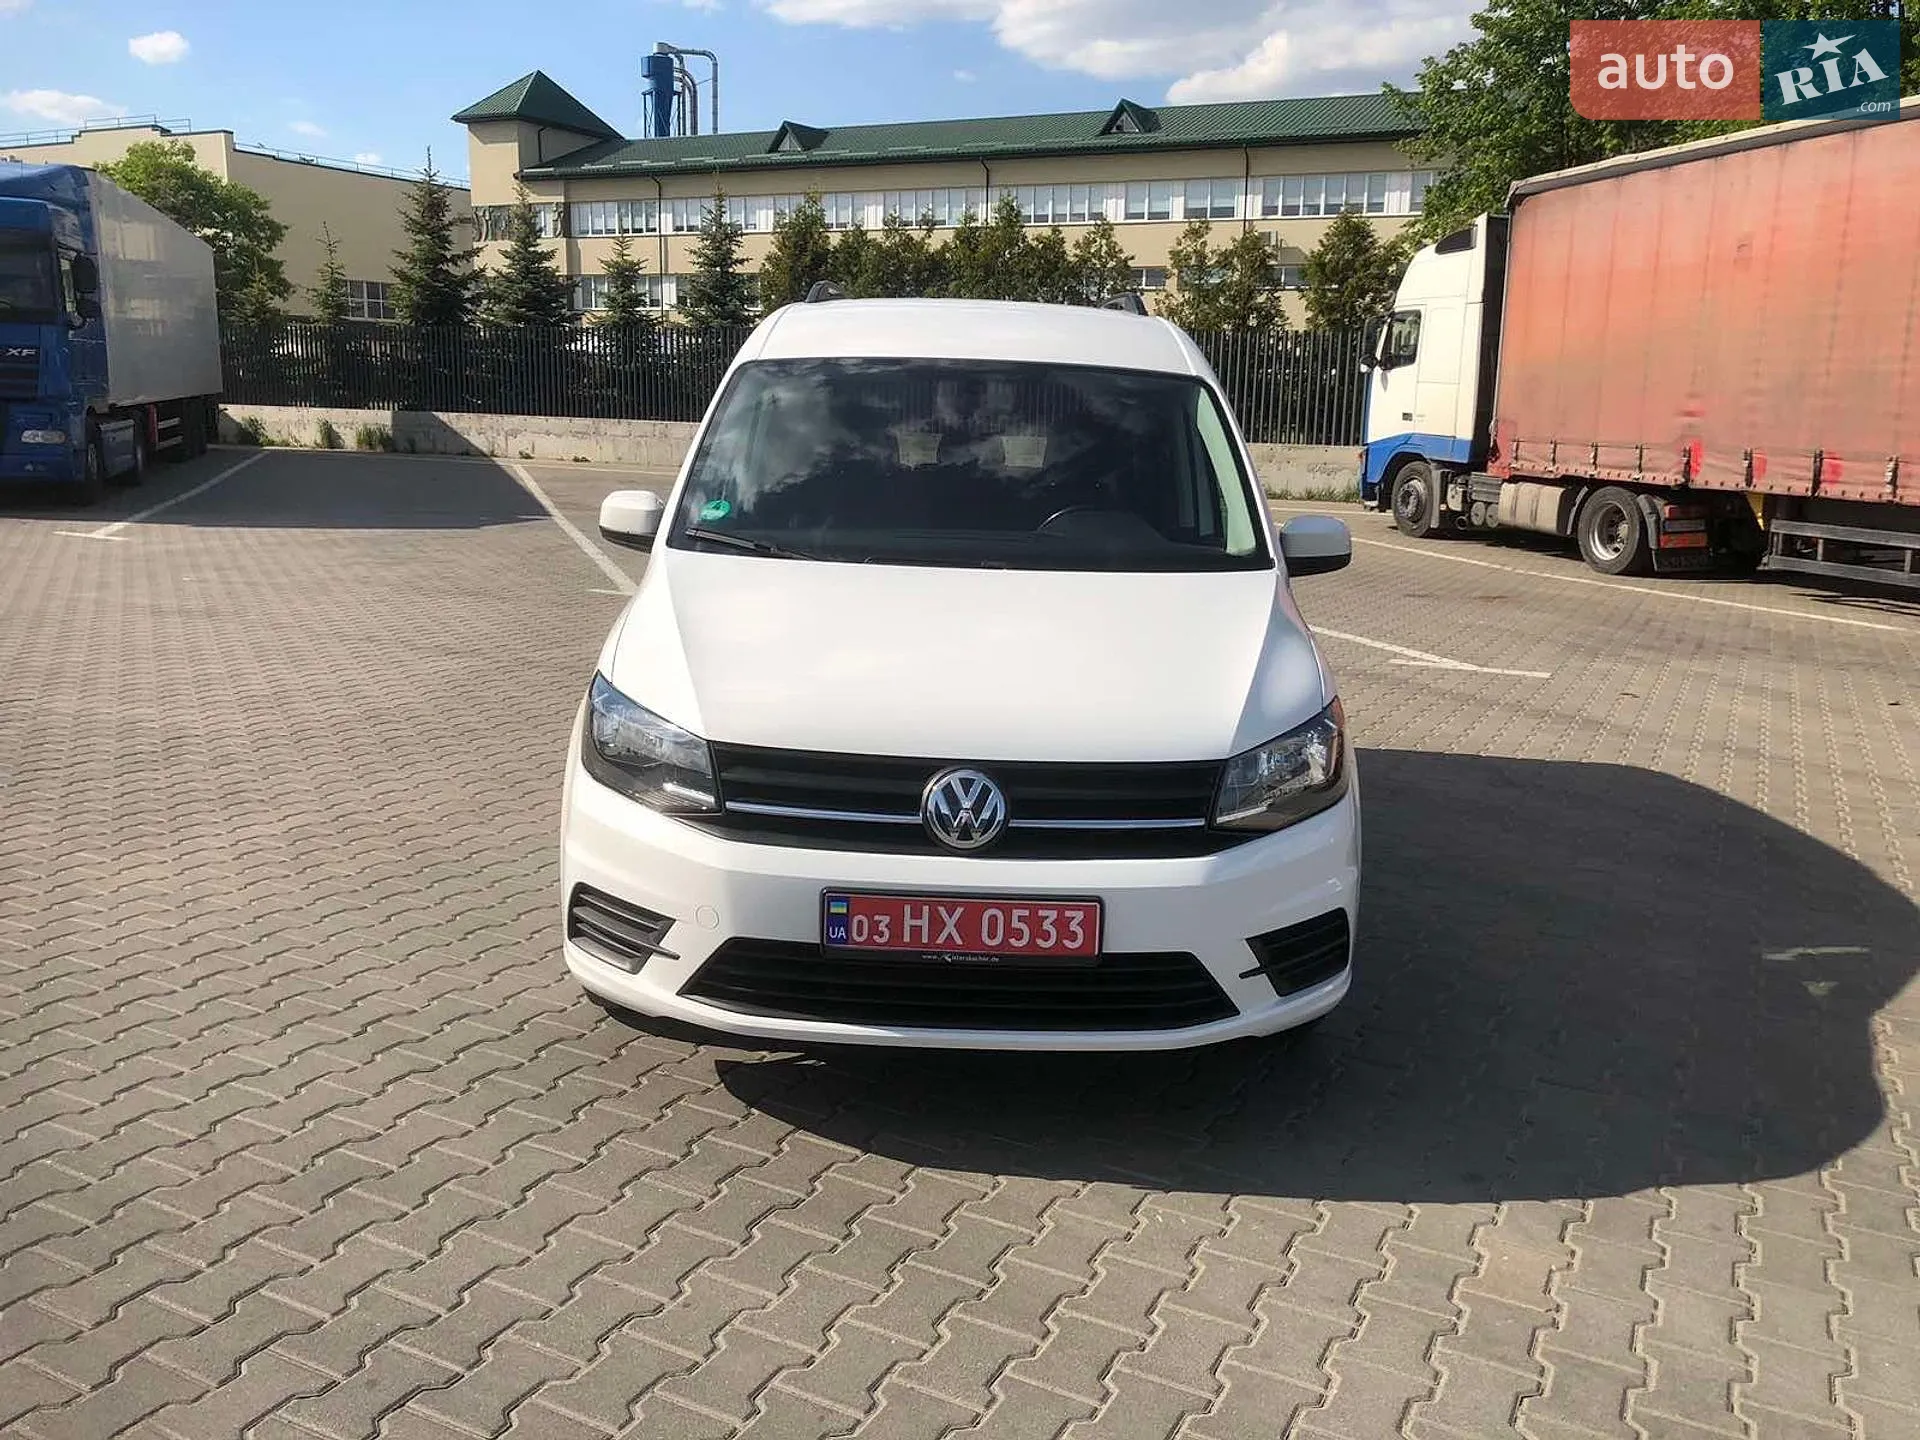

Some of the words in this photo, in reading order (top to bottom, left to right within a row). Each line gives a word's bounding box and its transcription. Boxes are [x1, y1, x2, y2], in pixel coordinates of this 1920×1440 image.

[6, 347, 37, 357] XF
[828, 926, 847, 940] UA
[851, 914, 891, 944] 03
[902, 903, 965, 946] HX
[981, 907, 1086, 949] 0533
